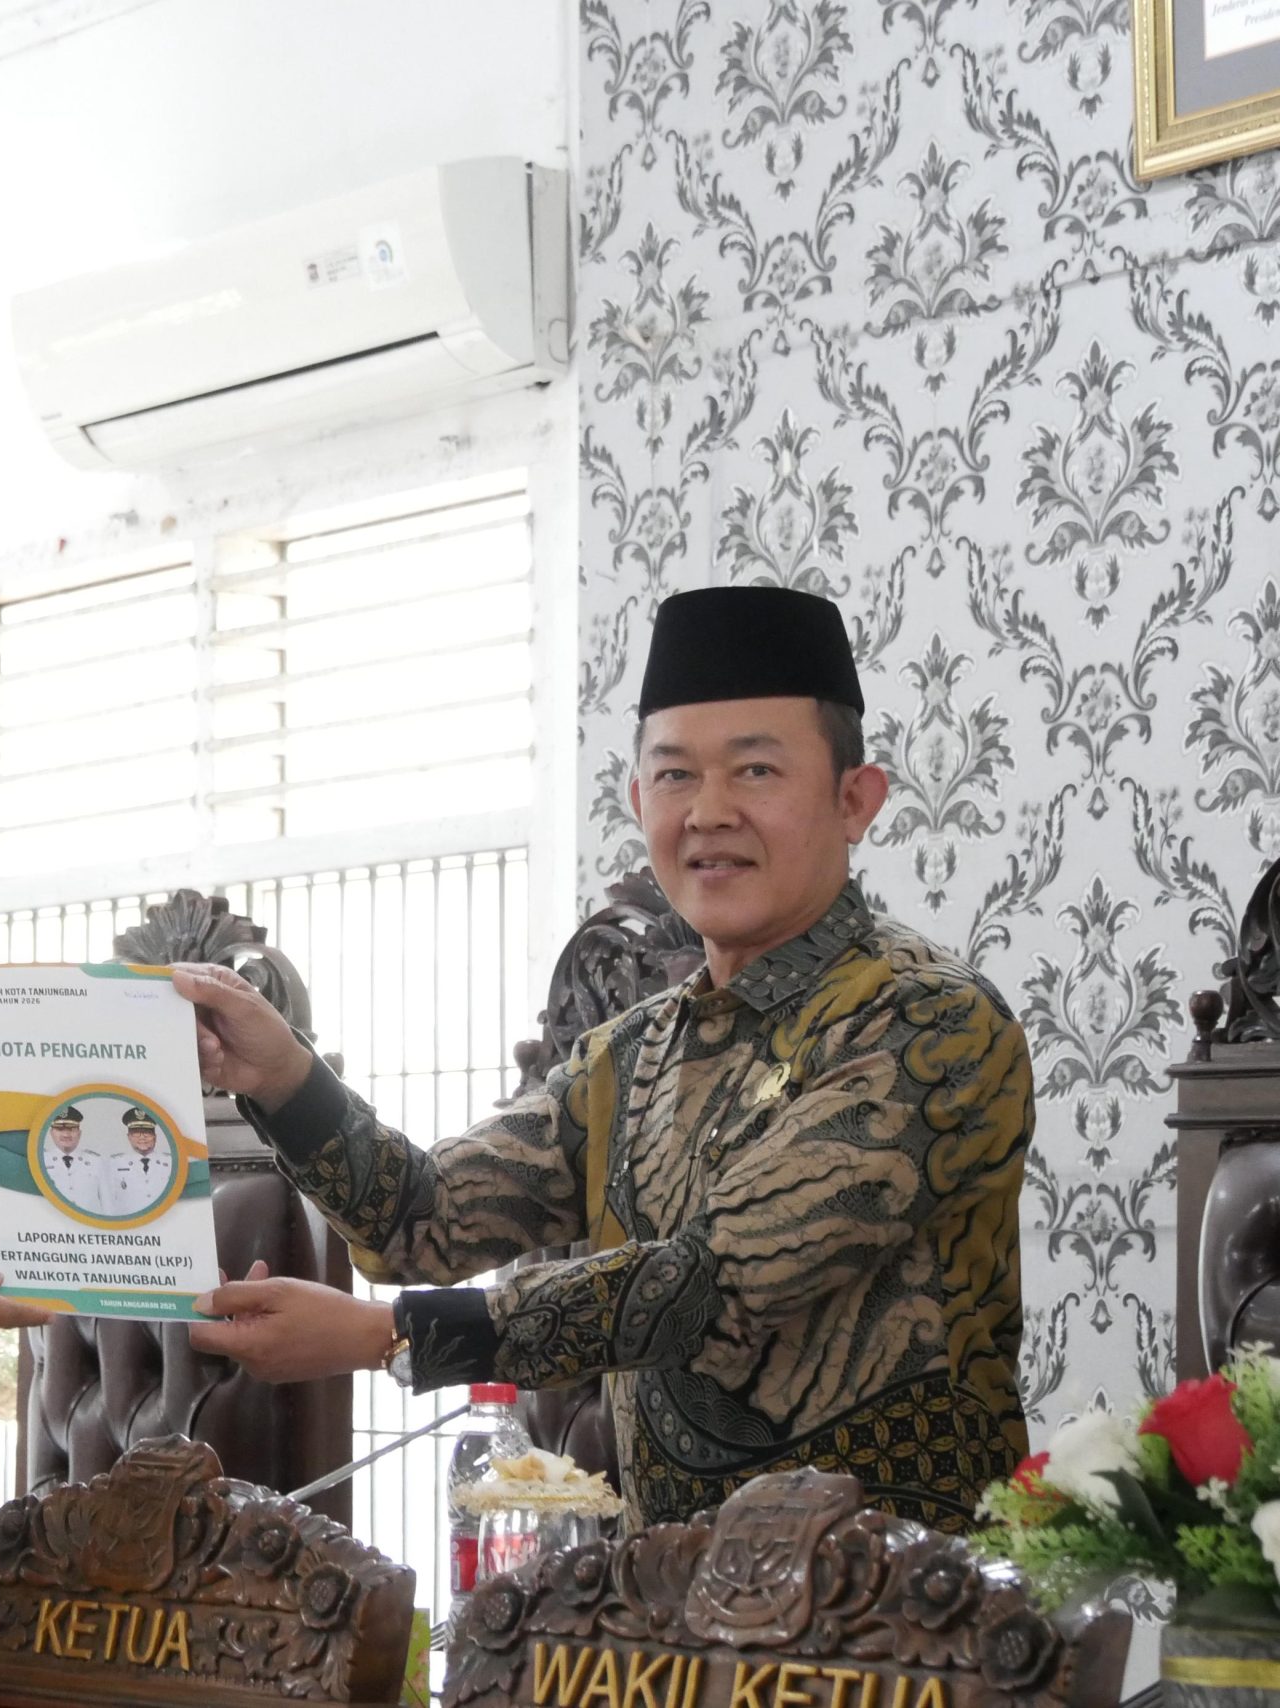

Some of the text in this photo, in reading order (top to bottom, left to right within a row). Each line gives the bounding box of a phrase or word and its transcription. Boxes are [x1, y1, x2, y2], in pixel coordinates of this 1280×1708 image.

[5, 987, 27, 997] KOTA
[29, 987, 88, 998] TANJUNGBALAI
[40, 1042, 148, 1060] PENGANTAR
[17, 1231, 162, 1247] LAPORAN KETERANGAN
[91, 1253, 152, 1267] JAWABAN
[155, 1255, 194, 1270] (LKPJ)
[15, 1269, 177, 1287] WALIKOTA TANJUNGBALAI
[99, 1299, 122, 1308] TAHUN
[33, 1599, 190, 1671] KETUA
